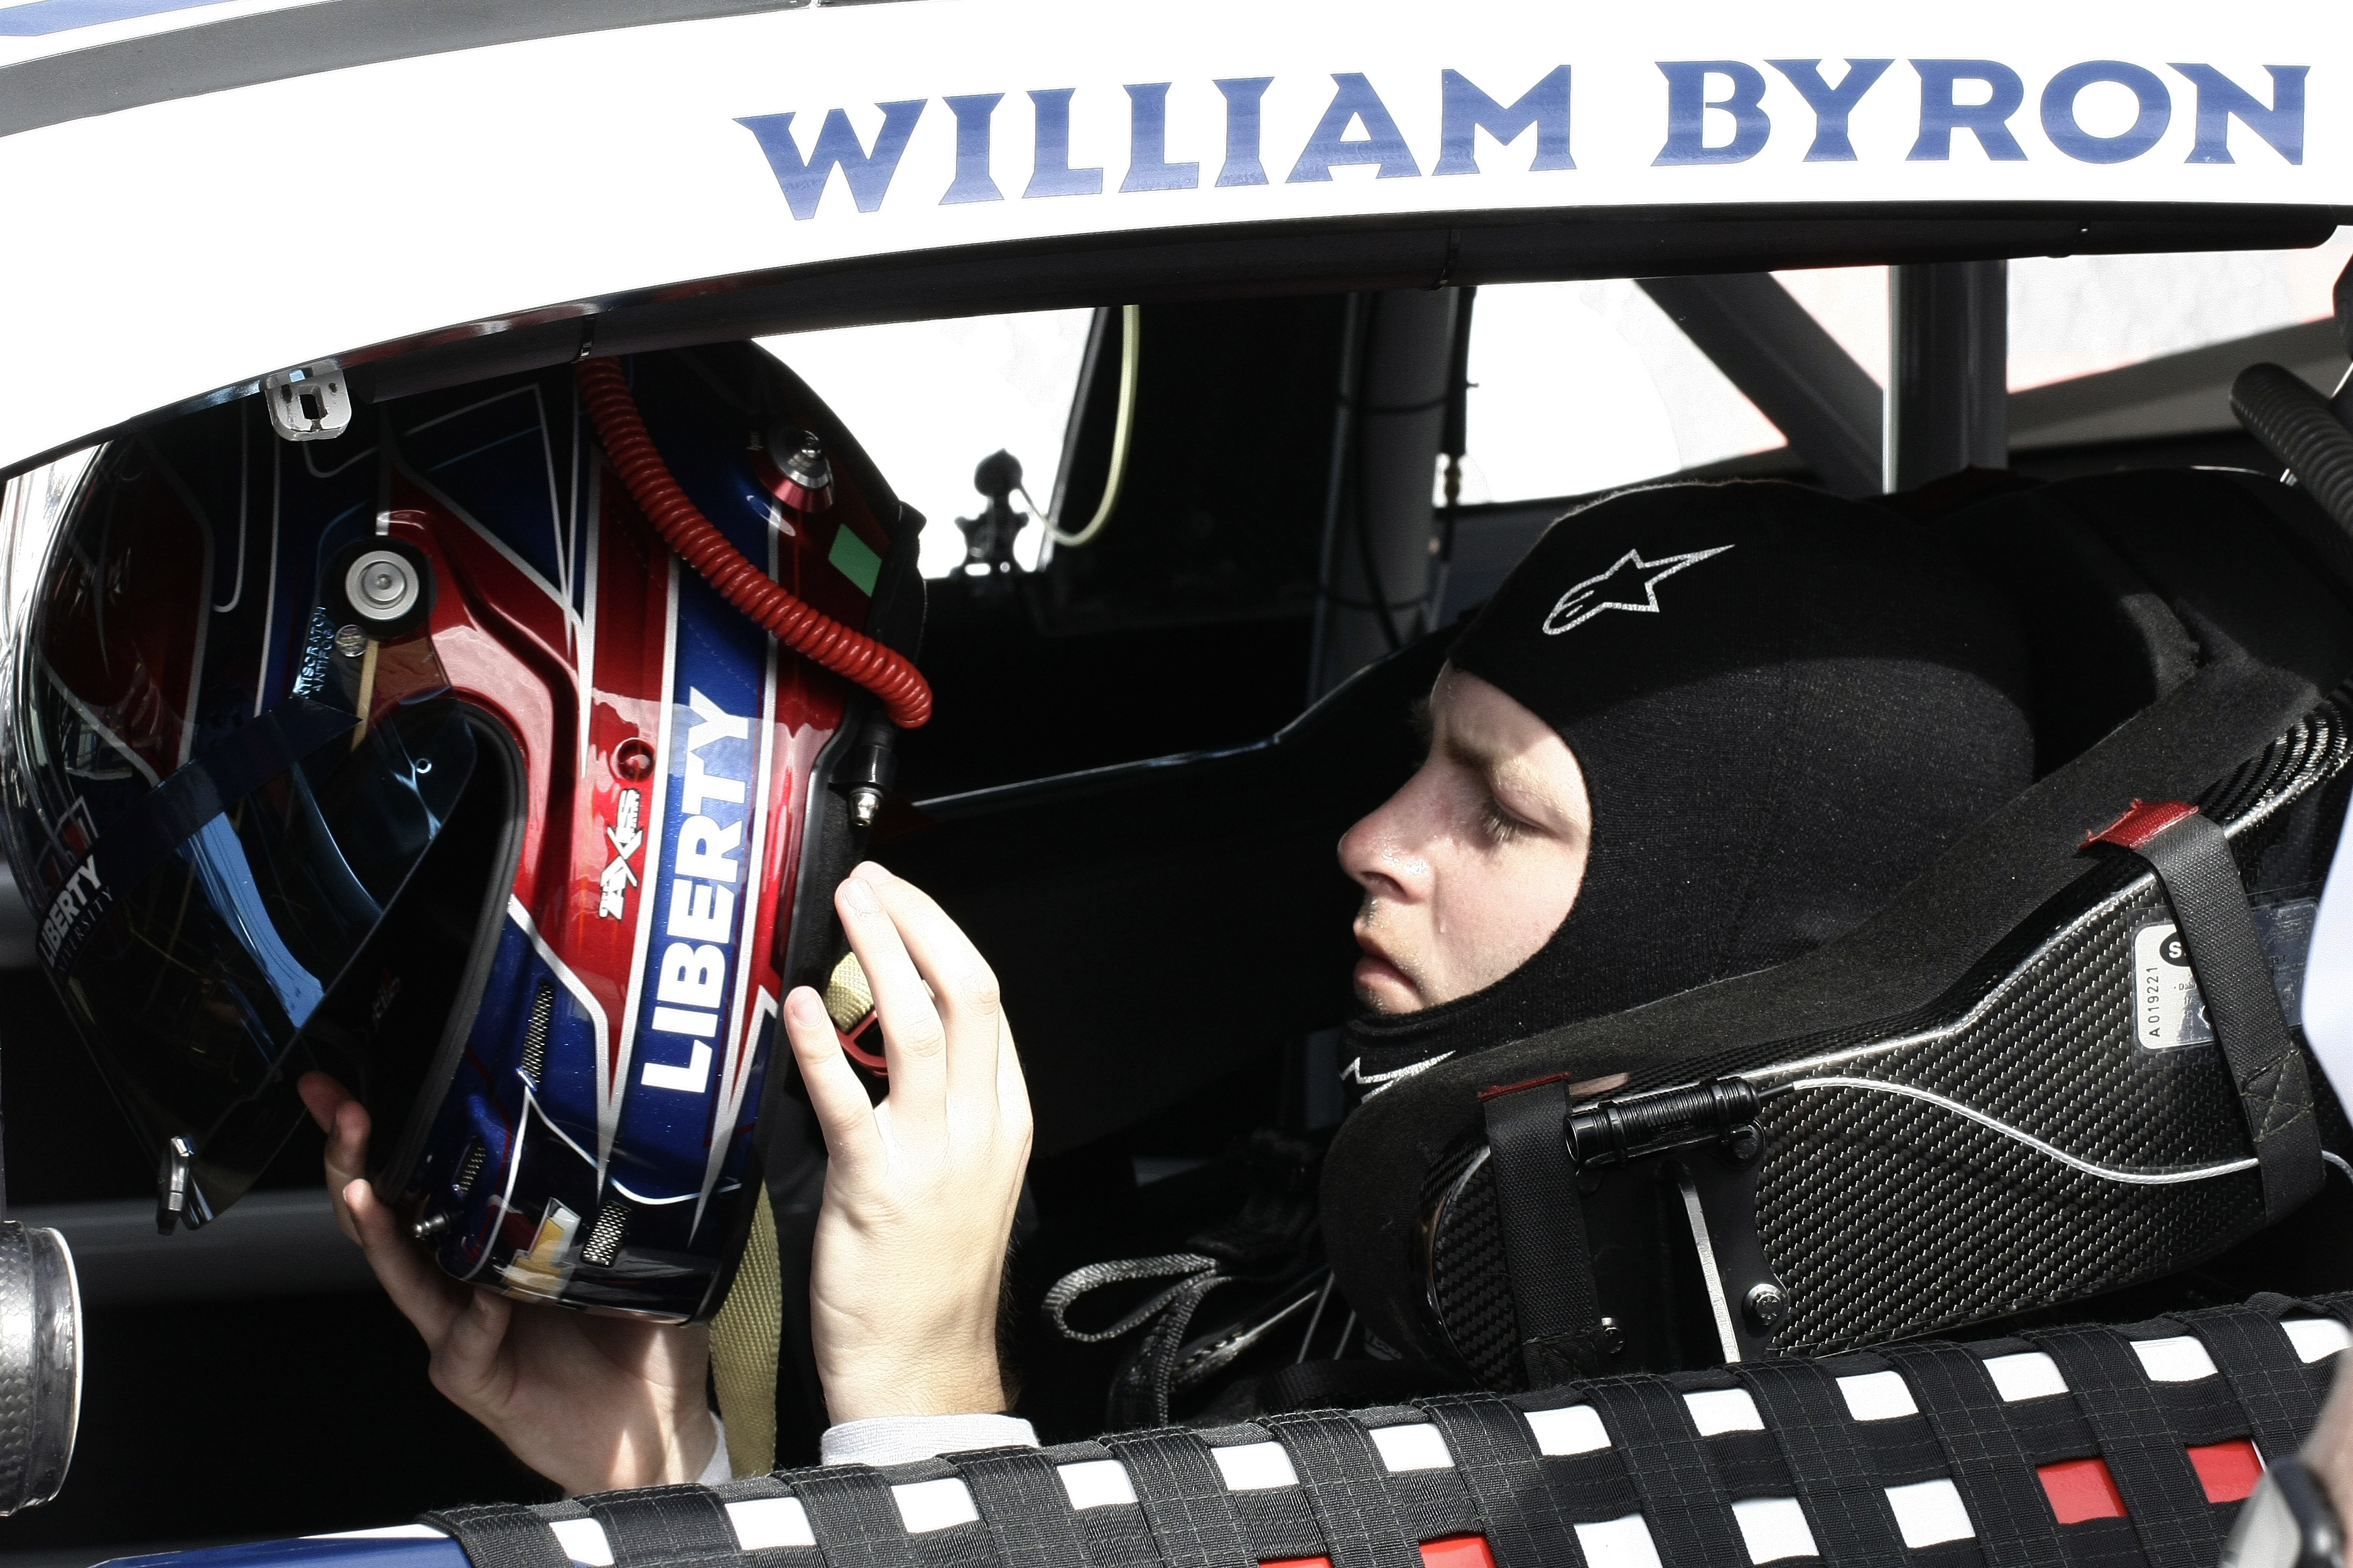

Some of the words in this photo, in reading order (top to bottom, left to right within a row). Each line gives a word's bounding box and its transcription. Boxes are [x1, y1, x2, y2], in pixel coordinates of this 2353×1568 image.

[732, 65, 1577, 221] WILLIAM
[1651, 58, 2312, 166] BYRON
[38, 853, 102, 968] LIBERTY
[641, 686, 751, 1093] LIBERTY
[2146, 966, 2161, 1037] A019221
